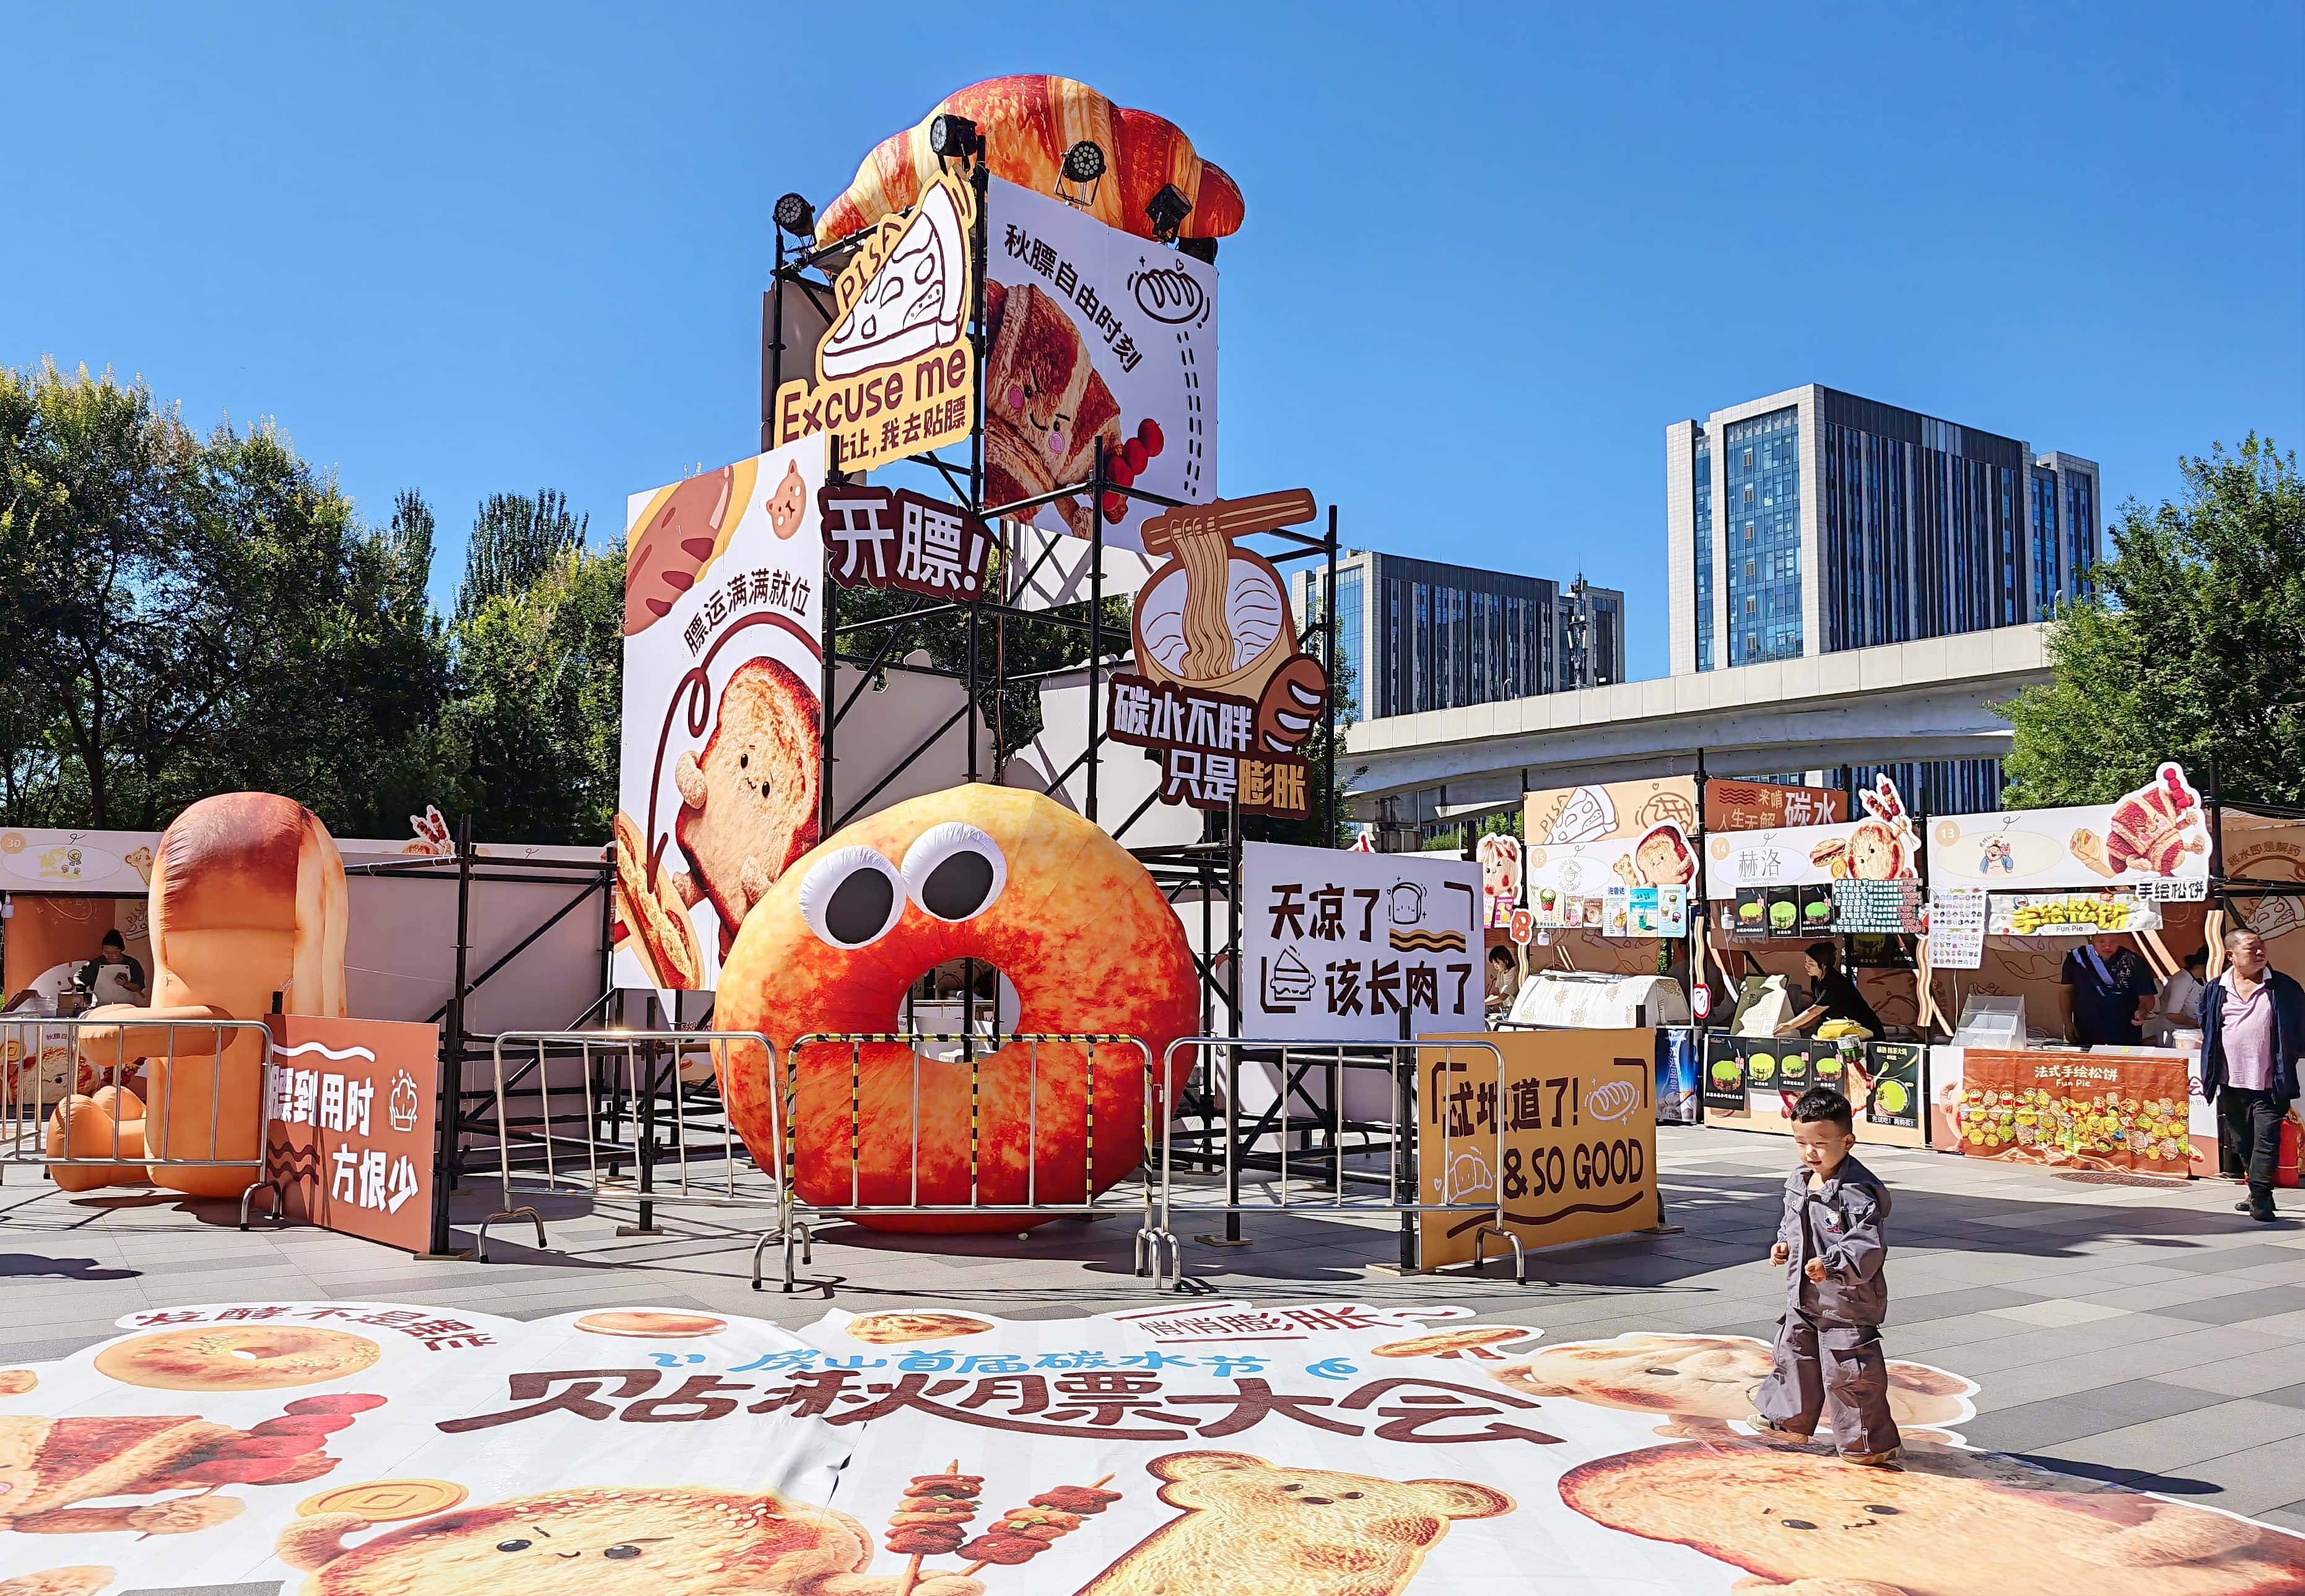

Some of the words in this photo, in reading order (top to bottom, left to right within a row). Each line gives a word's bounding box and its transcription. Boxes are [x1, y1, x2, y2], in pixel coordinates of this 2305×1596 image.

[842, 221, 902, 308] PISA
[1004, 224, 1143, 373] 秋膘自由时刻
[783, 373, 903, 443] Excuse
[916, 349, 965, 401] me
[827, 499, 983, 591] 开膘!
[684, 569, 811, 657] 膘运满满就位
[1114, 683, 1252, 752] 碳水不胖
[1167, 749, 1305, 810] 只是膨胀
[1540, 795, 1569, 833] PISA
[1759, 788, 1783, 809] 来啃
[1785, 791, 1836, 827] 碳水
[7, 840, 20, 848] 30
[1715, 844, 1726, 853] 14
[1941, 829, 1954, 839] 13
[2228, 841, 2302, 866] 碳水即是解药
[1535, 854, 1545, 863] 15
[1739, 848, 1781, 879] 赫洛
[1269, 883, 1380, 943] 天凉了
[2139, 881, 2204, 899] 手绘松饼
[2012, 896, 2129, 933] 手绘松饼
[1325, 958, 1471, 1016] 该长肉了
[2034, 1065, 2119, 1083] 法式手绘松饼
[269, 1065, 374, 1136] 膘到用时
[332, 1143, 419, 1215] 方恨少
[1573, 1138, 1644, 1190] GOOD
[136, 1307, 497, 1351] 发酵不是摆烂
[731, 1349, 1271, 1377] 房山首届碳水节
[436, 1369, 1569, 1444] 贴秋膘大会
